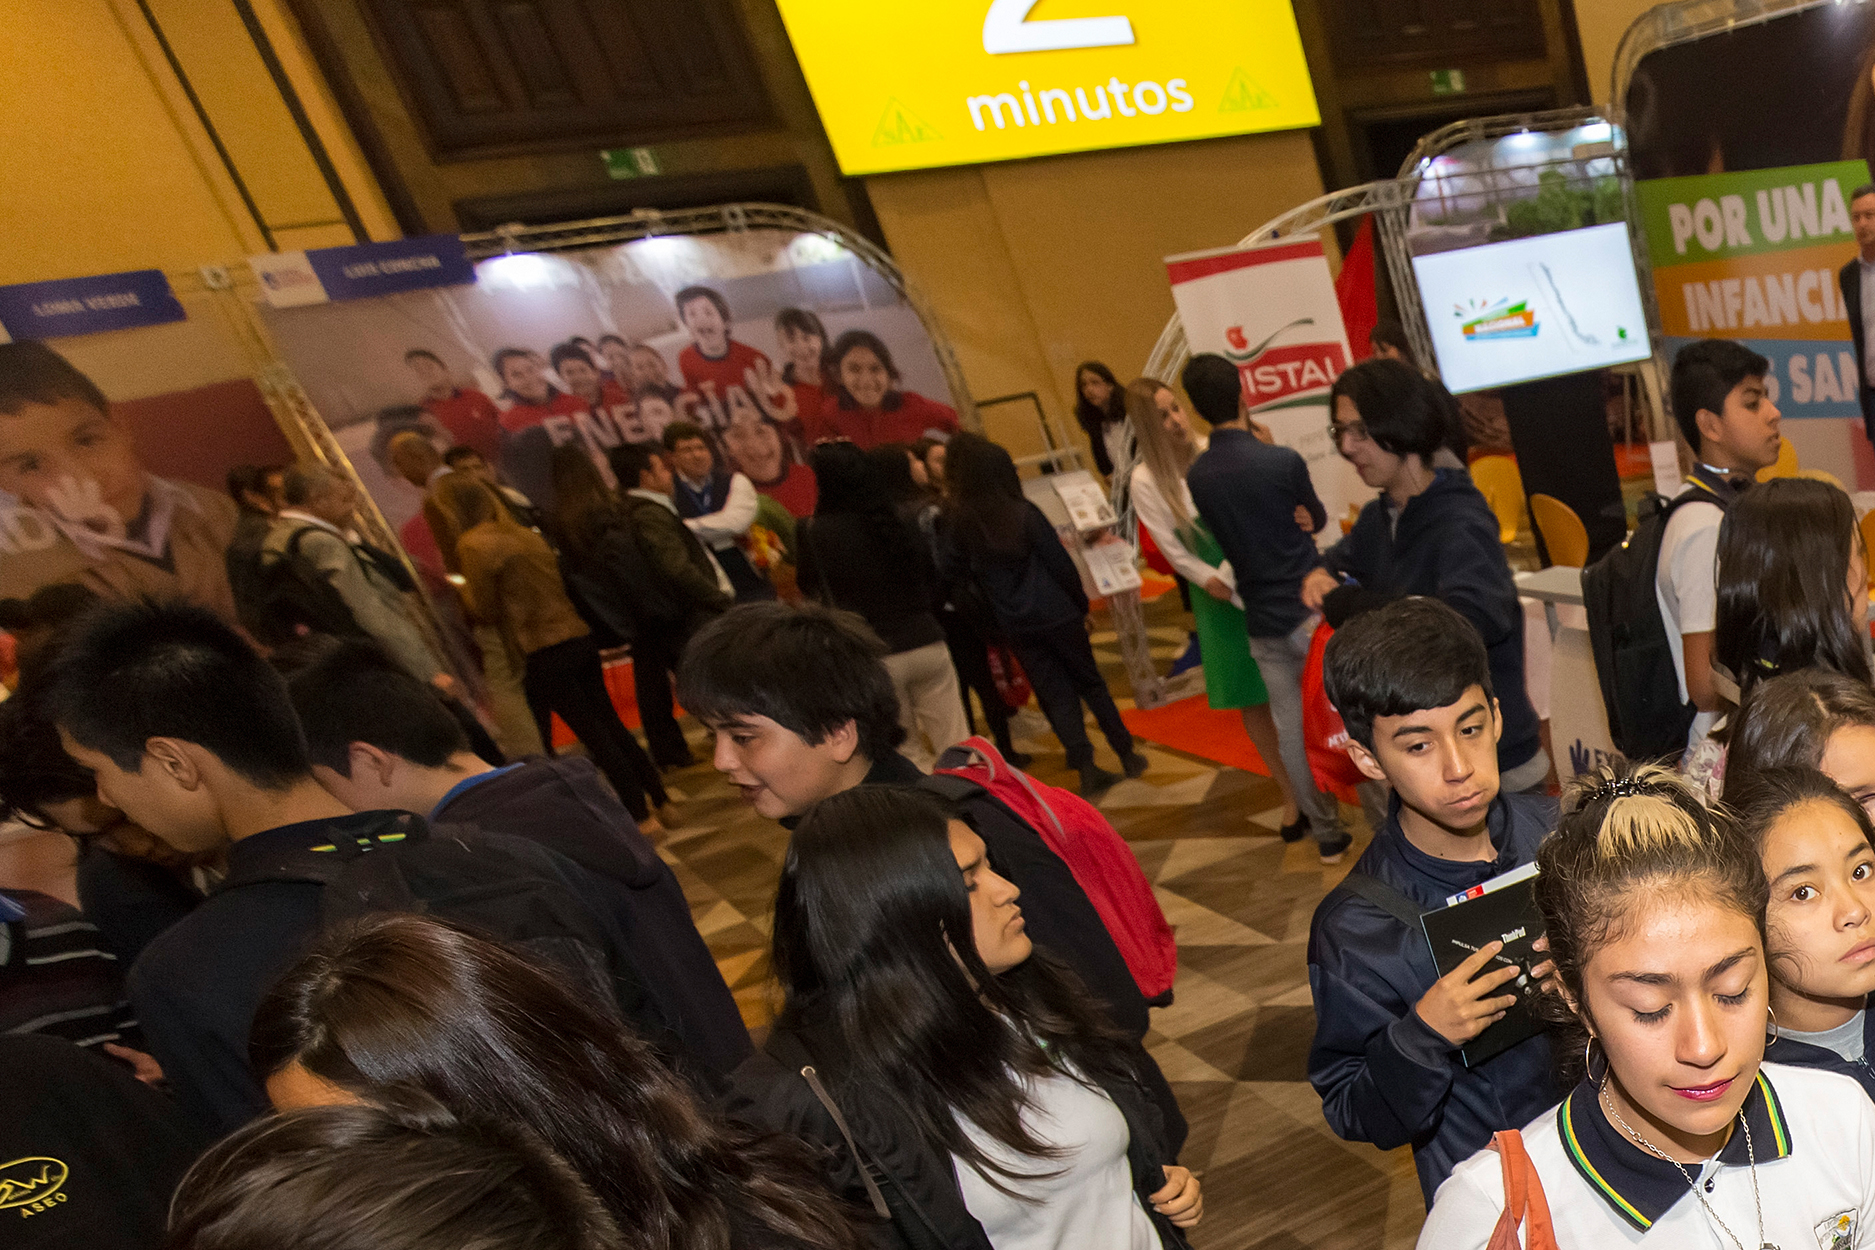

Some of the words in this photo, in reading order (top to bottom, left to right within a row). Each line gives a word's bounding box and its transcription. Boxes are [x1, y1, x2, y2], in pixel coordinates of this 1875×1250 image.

[967, 78, 1194, 131] minutos
[1668, 194, 1753, 254] POR
[1756, 178, 1854, 243] UNA
[1683, 268, 1849, 332] INFANCI
[1789, 351, 1859, 404] SAN
[20, 1192, 68, 1219] ASEO
